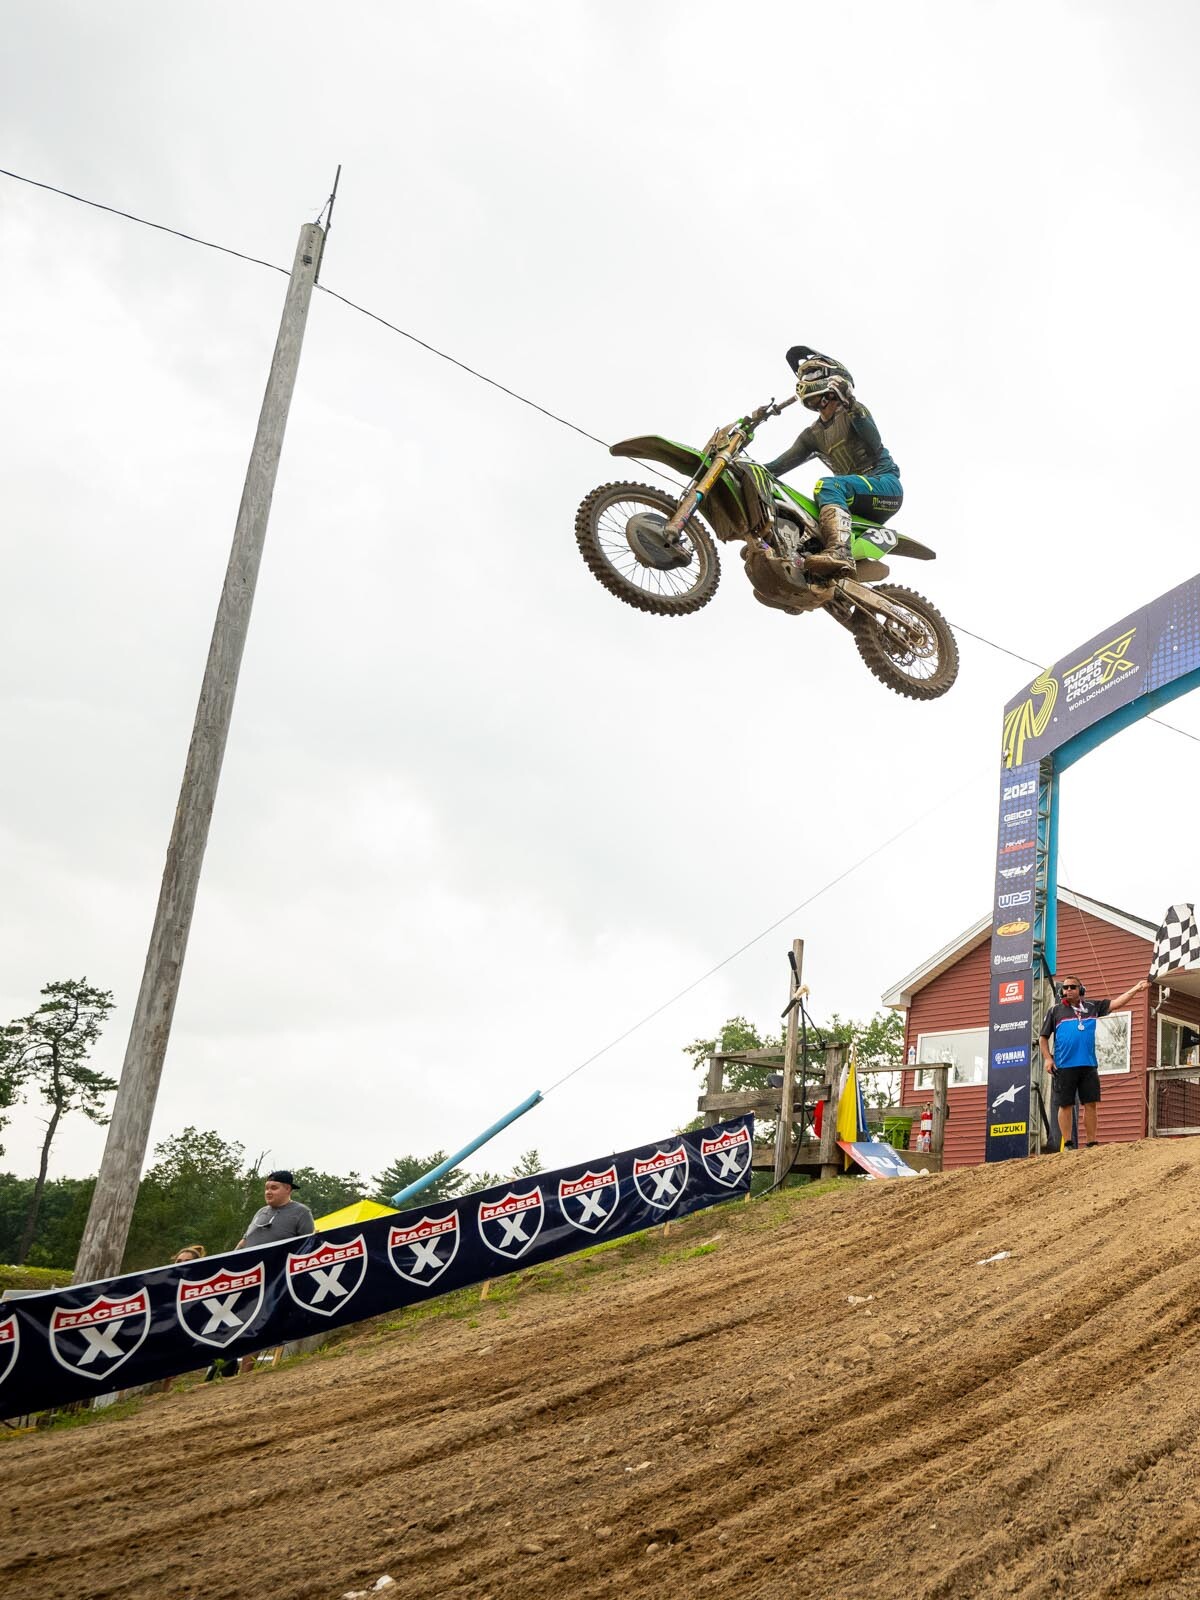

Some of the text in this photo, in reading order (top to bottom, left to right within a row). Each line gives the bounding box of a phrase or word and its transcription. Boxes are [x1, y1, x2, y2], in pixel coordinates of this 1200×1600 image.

[867, 527, 897, 546] 30
[1063, 658, 1103, 688] SUPER
[1067, 667, 1102, 693] MOTO
[1066, 674, 1104, 703] CROSS
[1069, 665, 1140, 712] WORLD CHAMPIONSHIP
[1003, 780, 1036, 801] 2023
[1004, 809, 1032, 822] GEICO
[999, 891, 1031, 908] WPS
[1002, 1050, 1025, 1061] YAMAHA
[993, 1125, 1023, 1135] SUZUKI
[705, 1134, 745, 1153] RACER
[637, 1154, 683, 1174] RACER
[717, 1147, 743, 1178] X
[563, 1174, 613, 1195] RACER
[650, 1168, 679, 1201] X
[483, 1196, 538, 1219] RACER
[575, 1189, 608, 1224] X
[394, 1221, 454, 1244] RACER
[497, 1211, 531, 1249] X
[293, 1248, 359, 1271] RACER
[408, 1236, 445, 1275] X
[184, 1274, 258, 1299] RACER
[309, 1262, 349, 1305] X
[59, 1301, 141, 1327] RACER
[201, 1291, 244, 1335] X
[76, 1319, 126, 1366] X
